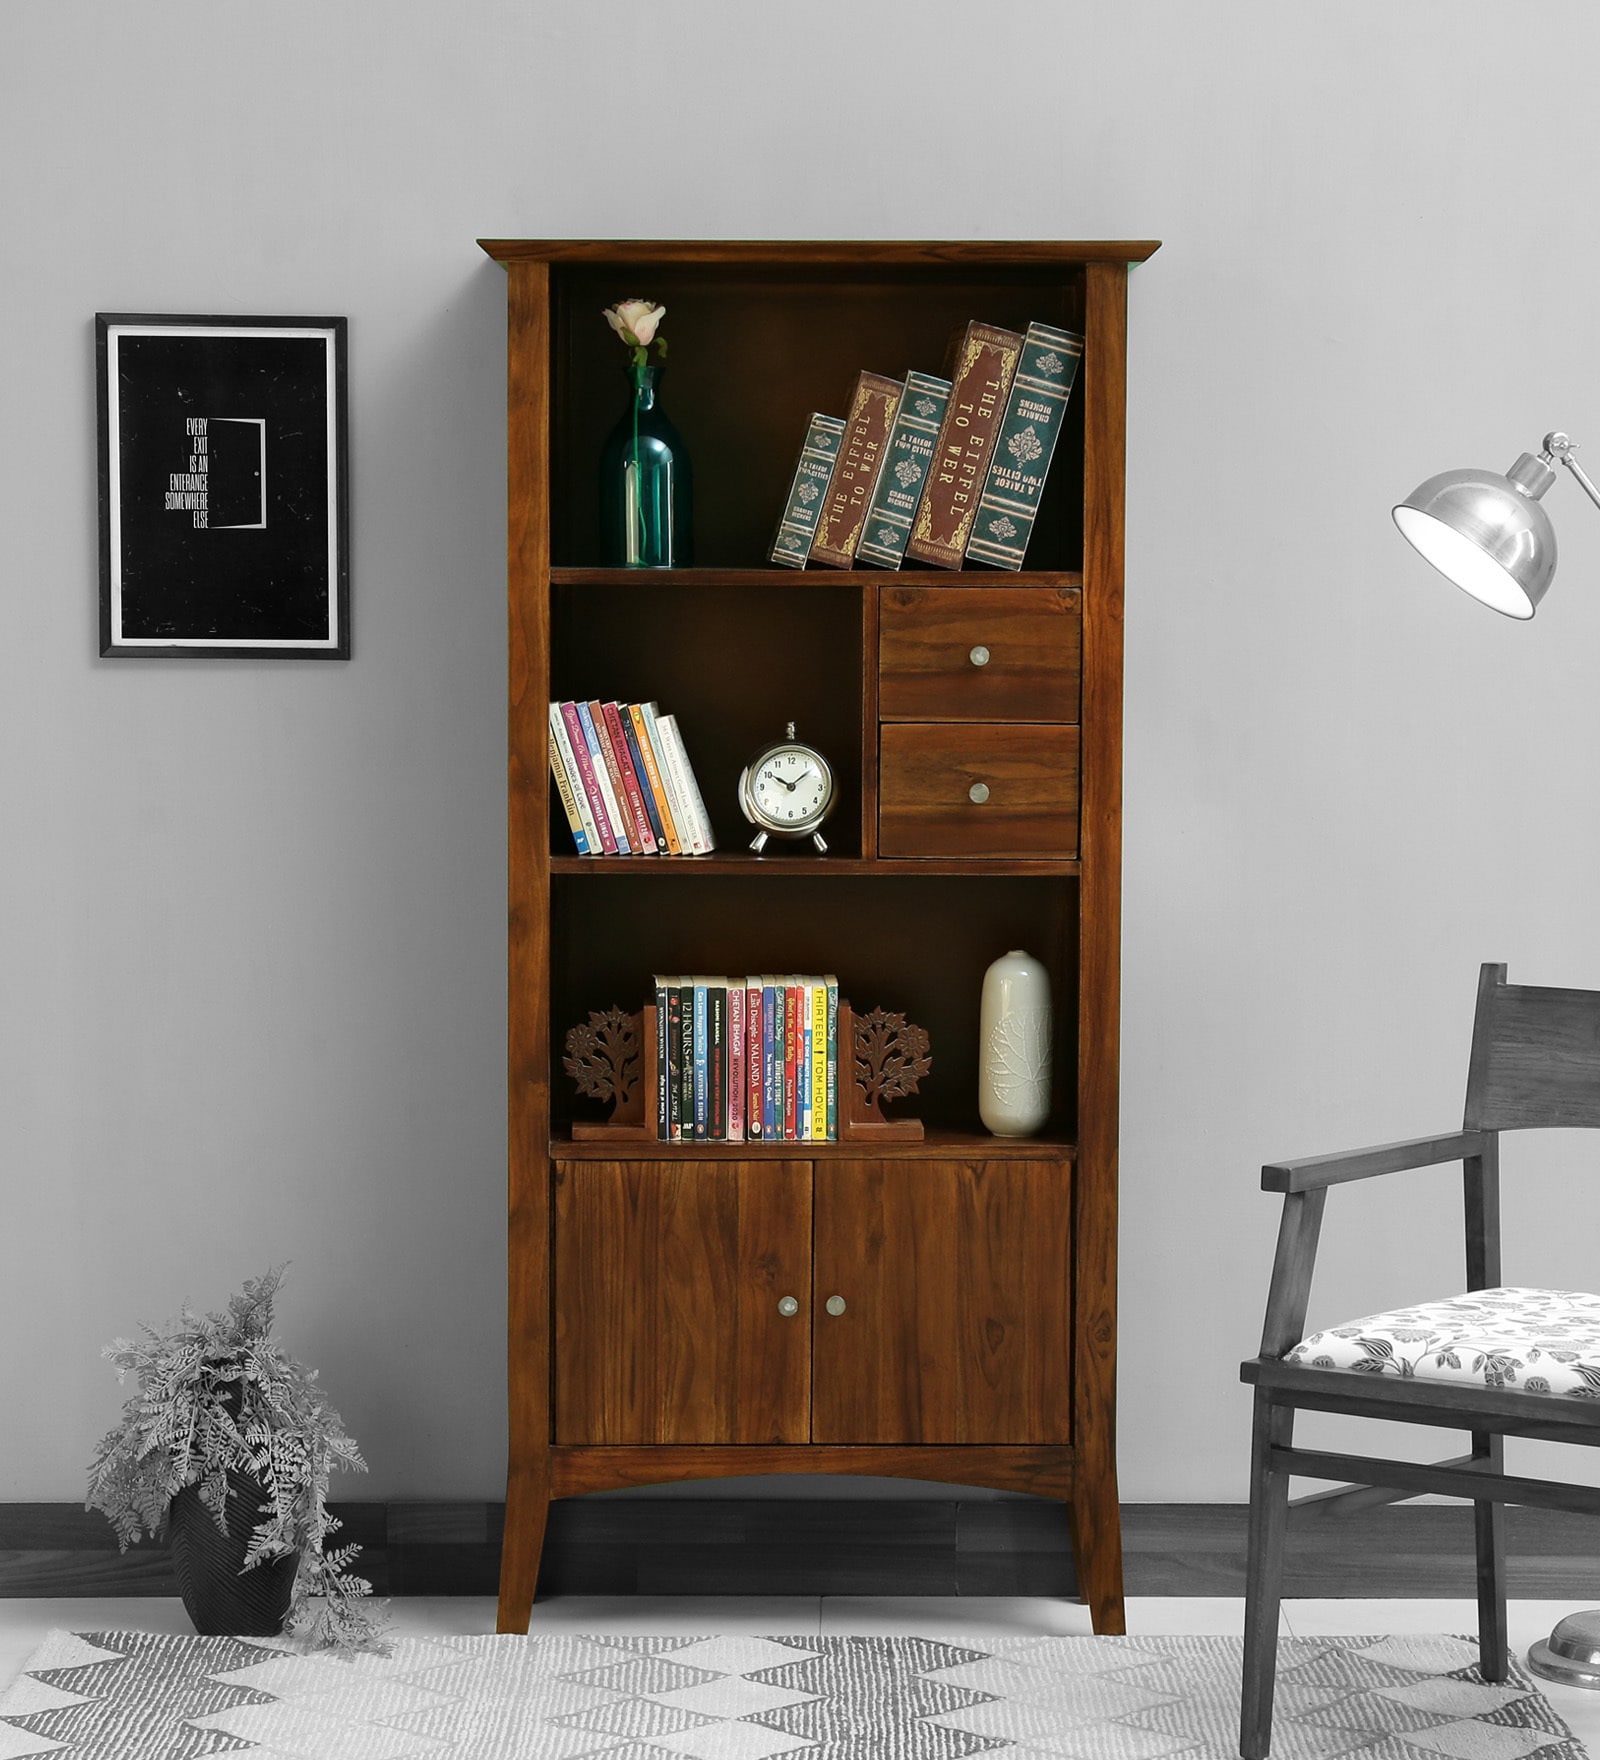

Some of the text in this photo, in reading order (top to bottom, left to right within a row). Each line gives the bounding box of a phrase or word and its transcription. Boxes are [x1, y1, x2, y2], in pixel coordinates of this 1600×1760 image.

[955, 403, 973, 428] TO
[1020, 399, 1052, 415] DICKENS
[1017, 409, 1049, 424] CHARLES
[186, 418, 208, 436] EVERY
[194, 436, 208, 454] EXIT
[951, 380, 999, 516] THE EIFFEL
[190, 455, 208, 473] IS AN
[830, 416, 870, 524] THE EIFFEL
[170, 473, 208, 491] ENTERANCE
[992, 466, 1021, 482] CITIES
[165, 492, 208, 510] SOMEWHERE
[851, 486, 865, 505] TO
[193, 510, 208, 528] ELSE
[606, 707, 630, 770] CHETAN BHAGAT
[565, 756, 578, 781] Shades
[576, 792, 586, 809] Love
[558, 780, 576, 816] Franklin
[599, 821, 610, 838] SINGH
[682, 1002, 692, 1012] 12
[749, 1010, 758, 1038] Disciple
[682, 1014, 692, 1055] HOURS
[815, 1088, 823, 1123] HOYLE
